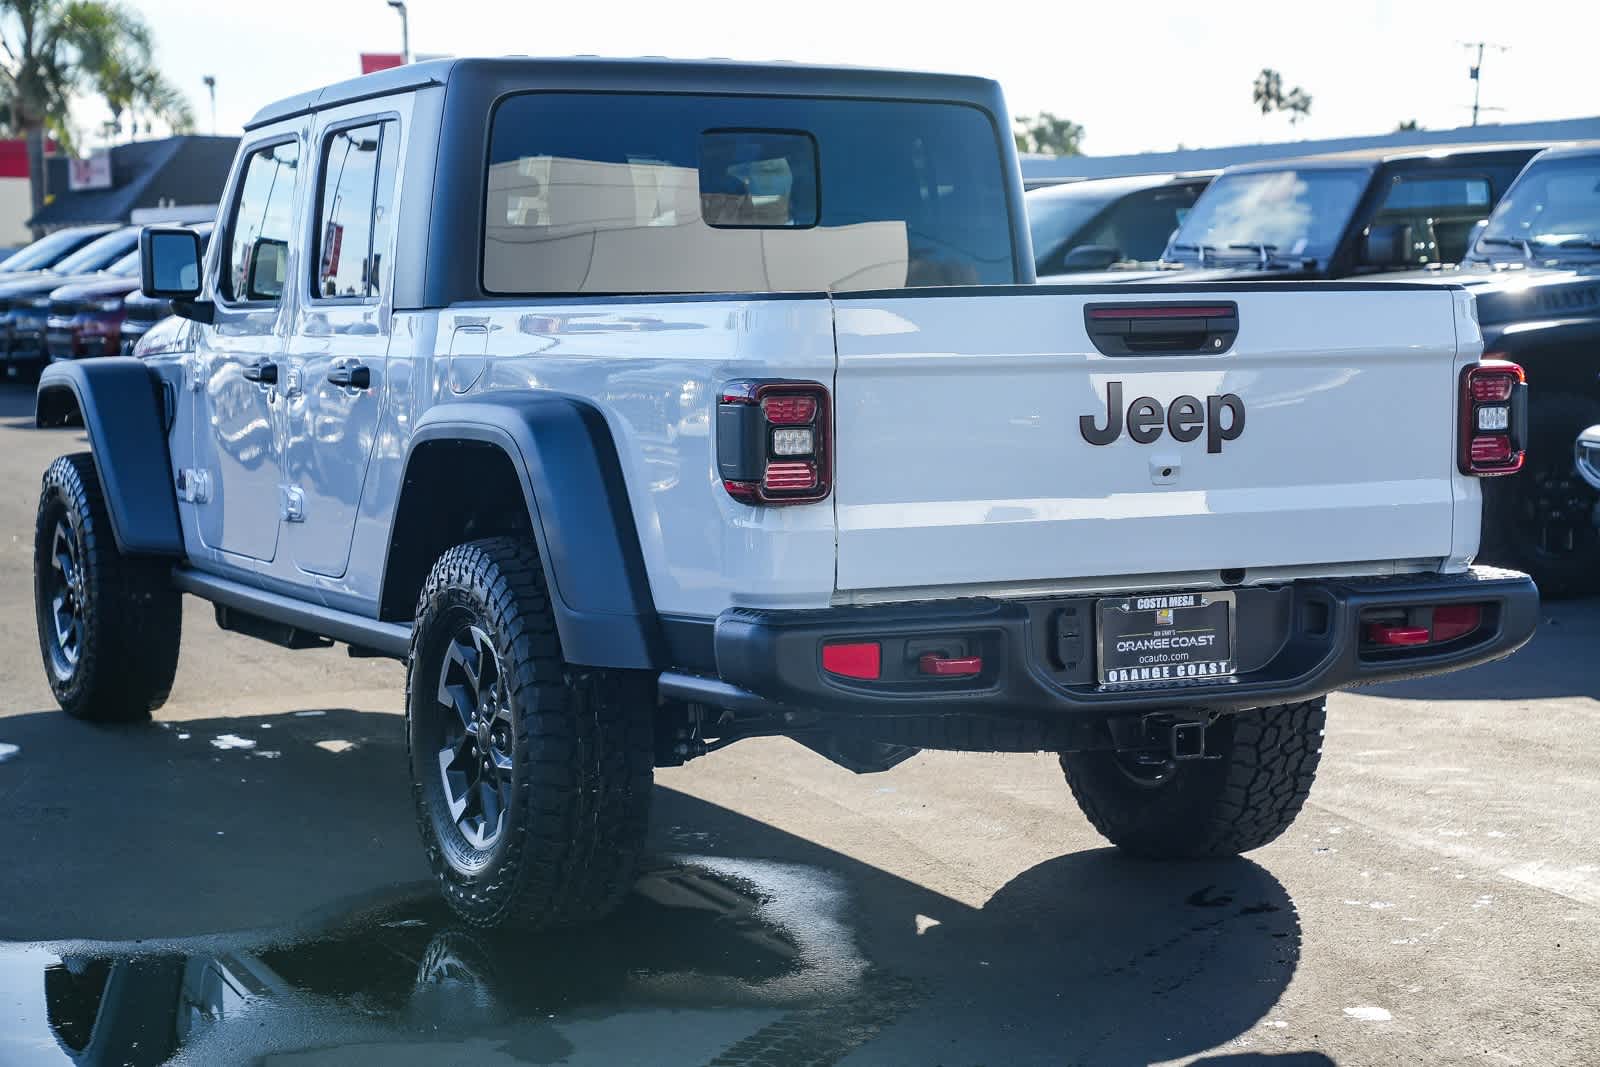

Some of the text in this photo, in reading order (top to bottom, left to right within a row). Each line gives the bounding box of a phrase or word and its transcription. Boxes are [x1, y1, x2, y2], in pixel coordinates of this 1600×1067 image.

[1079, 381, 1246, 454] Jeep
[1137, 595, 1195, 610] COSTA MESA
[1116, 635, 1215, 652] ORANGE COAST
[1139, 651, 1189, 664] ocauto.com
[1108, 662, 1228, 682] ORANGE COAST
